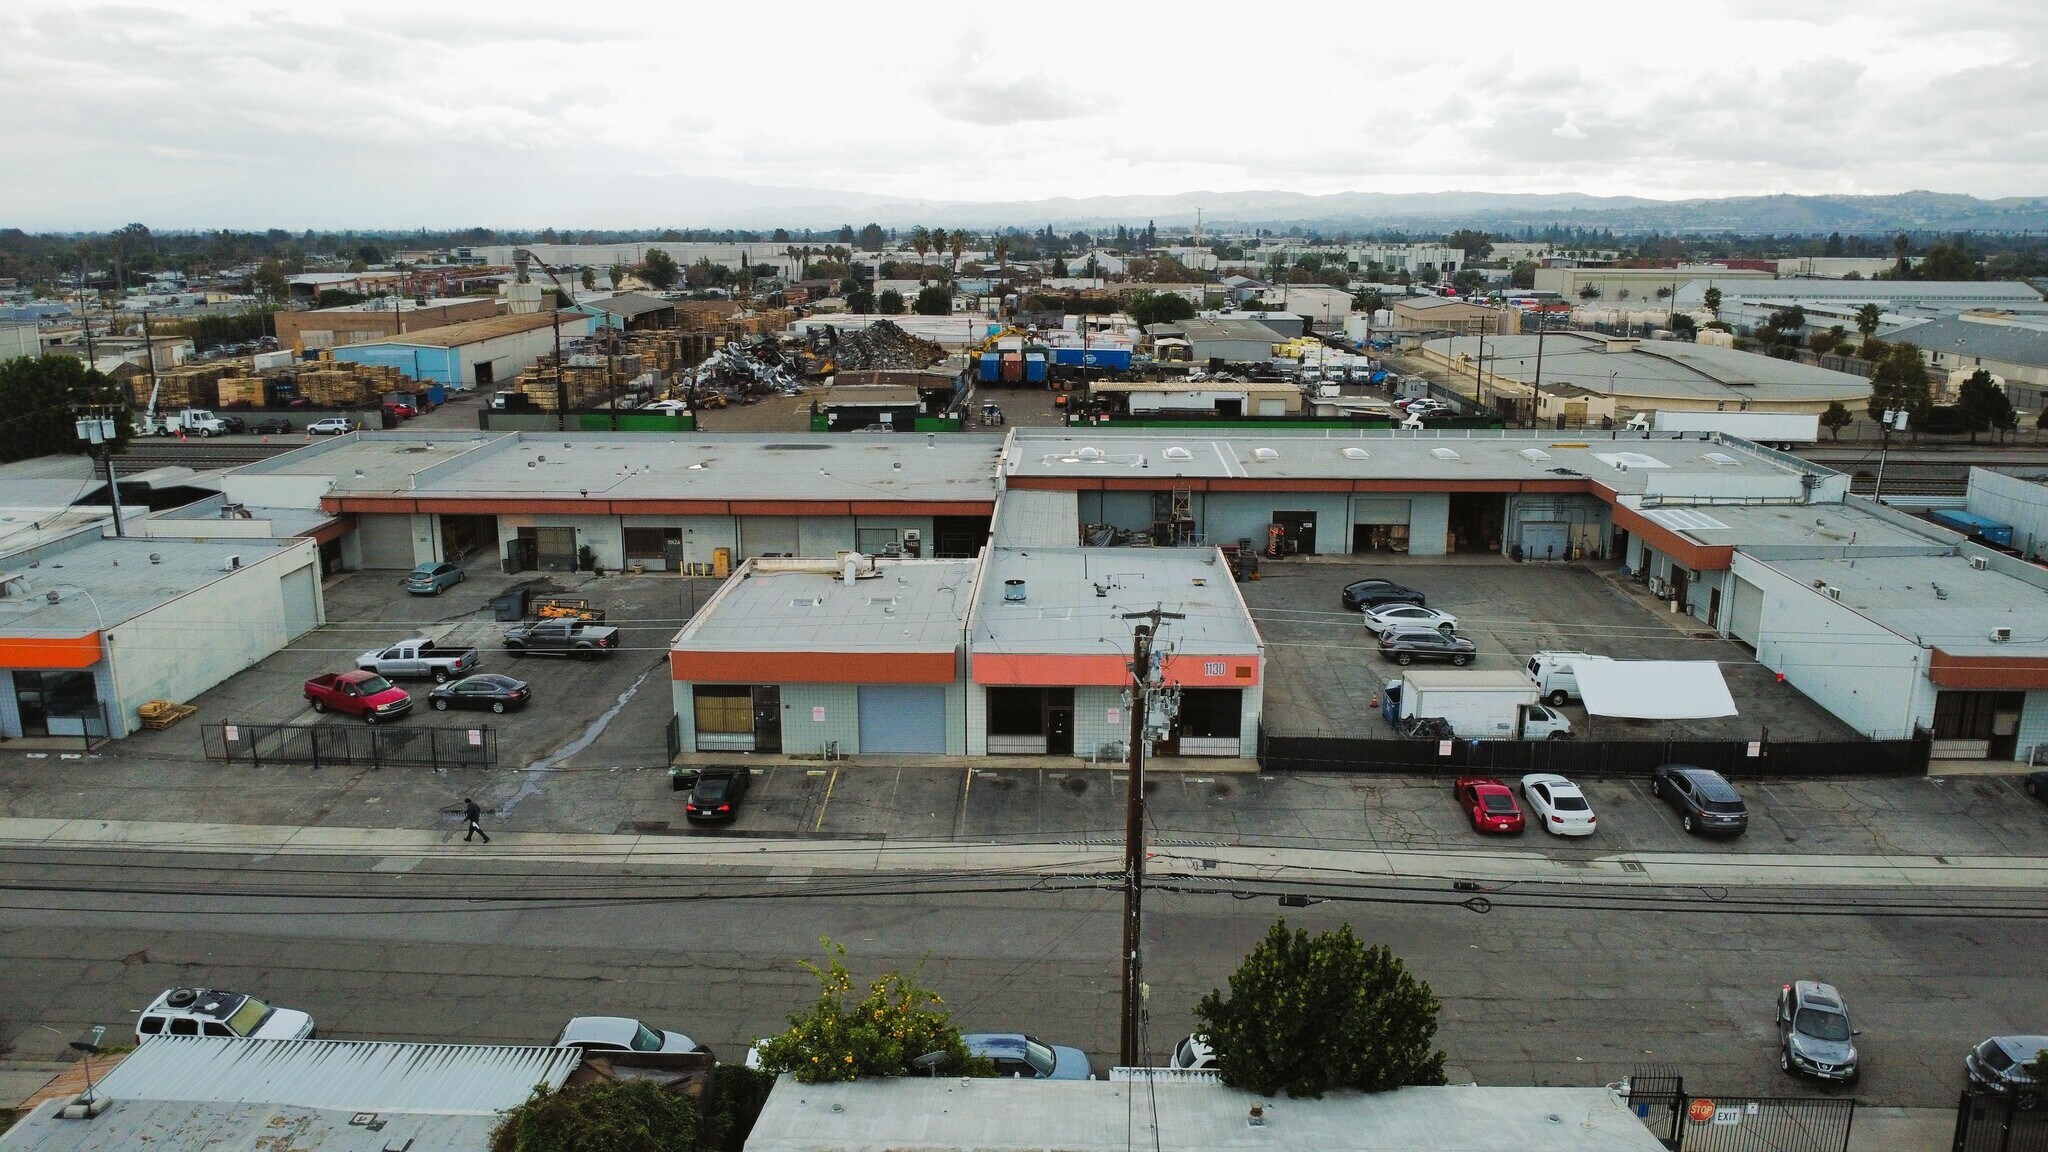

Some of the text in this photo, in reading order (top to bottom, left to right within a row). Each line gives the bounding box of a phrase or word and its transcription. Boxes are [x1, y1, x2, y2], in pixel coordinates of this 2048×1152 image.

[1204, 662, 1226, 676] 1130
[1691, 1105, 1713, 1115] STOP
[1717, 1112, 1738, 1121] EXIT
